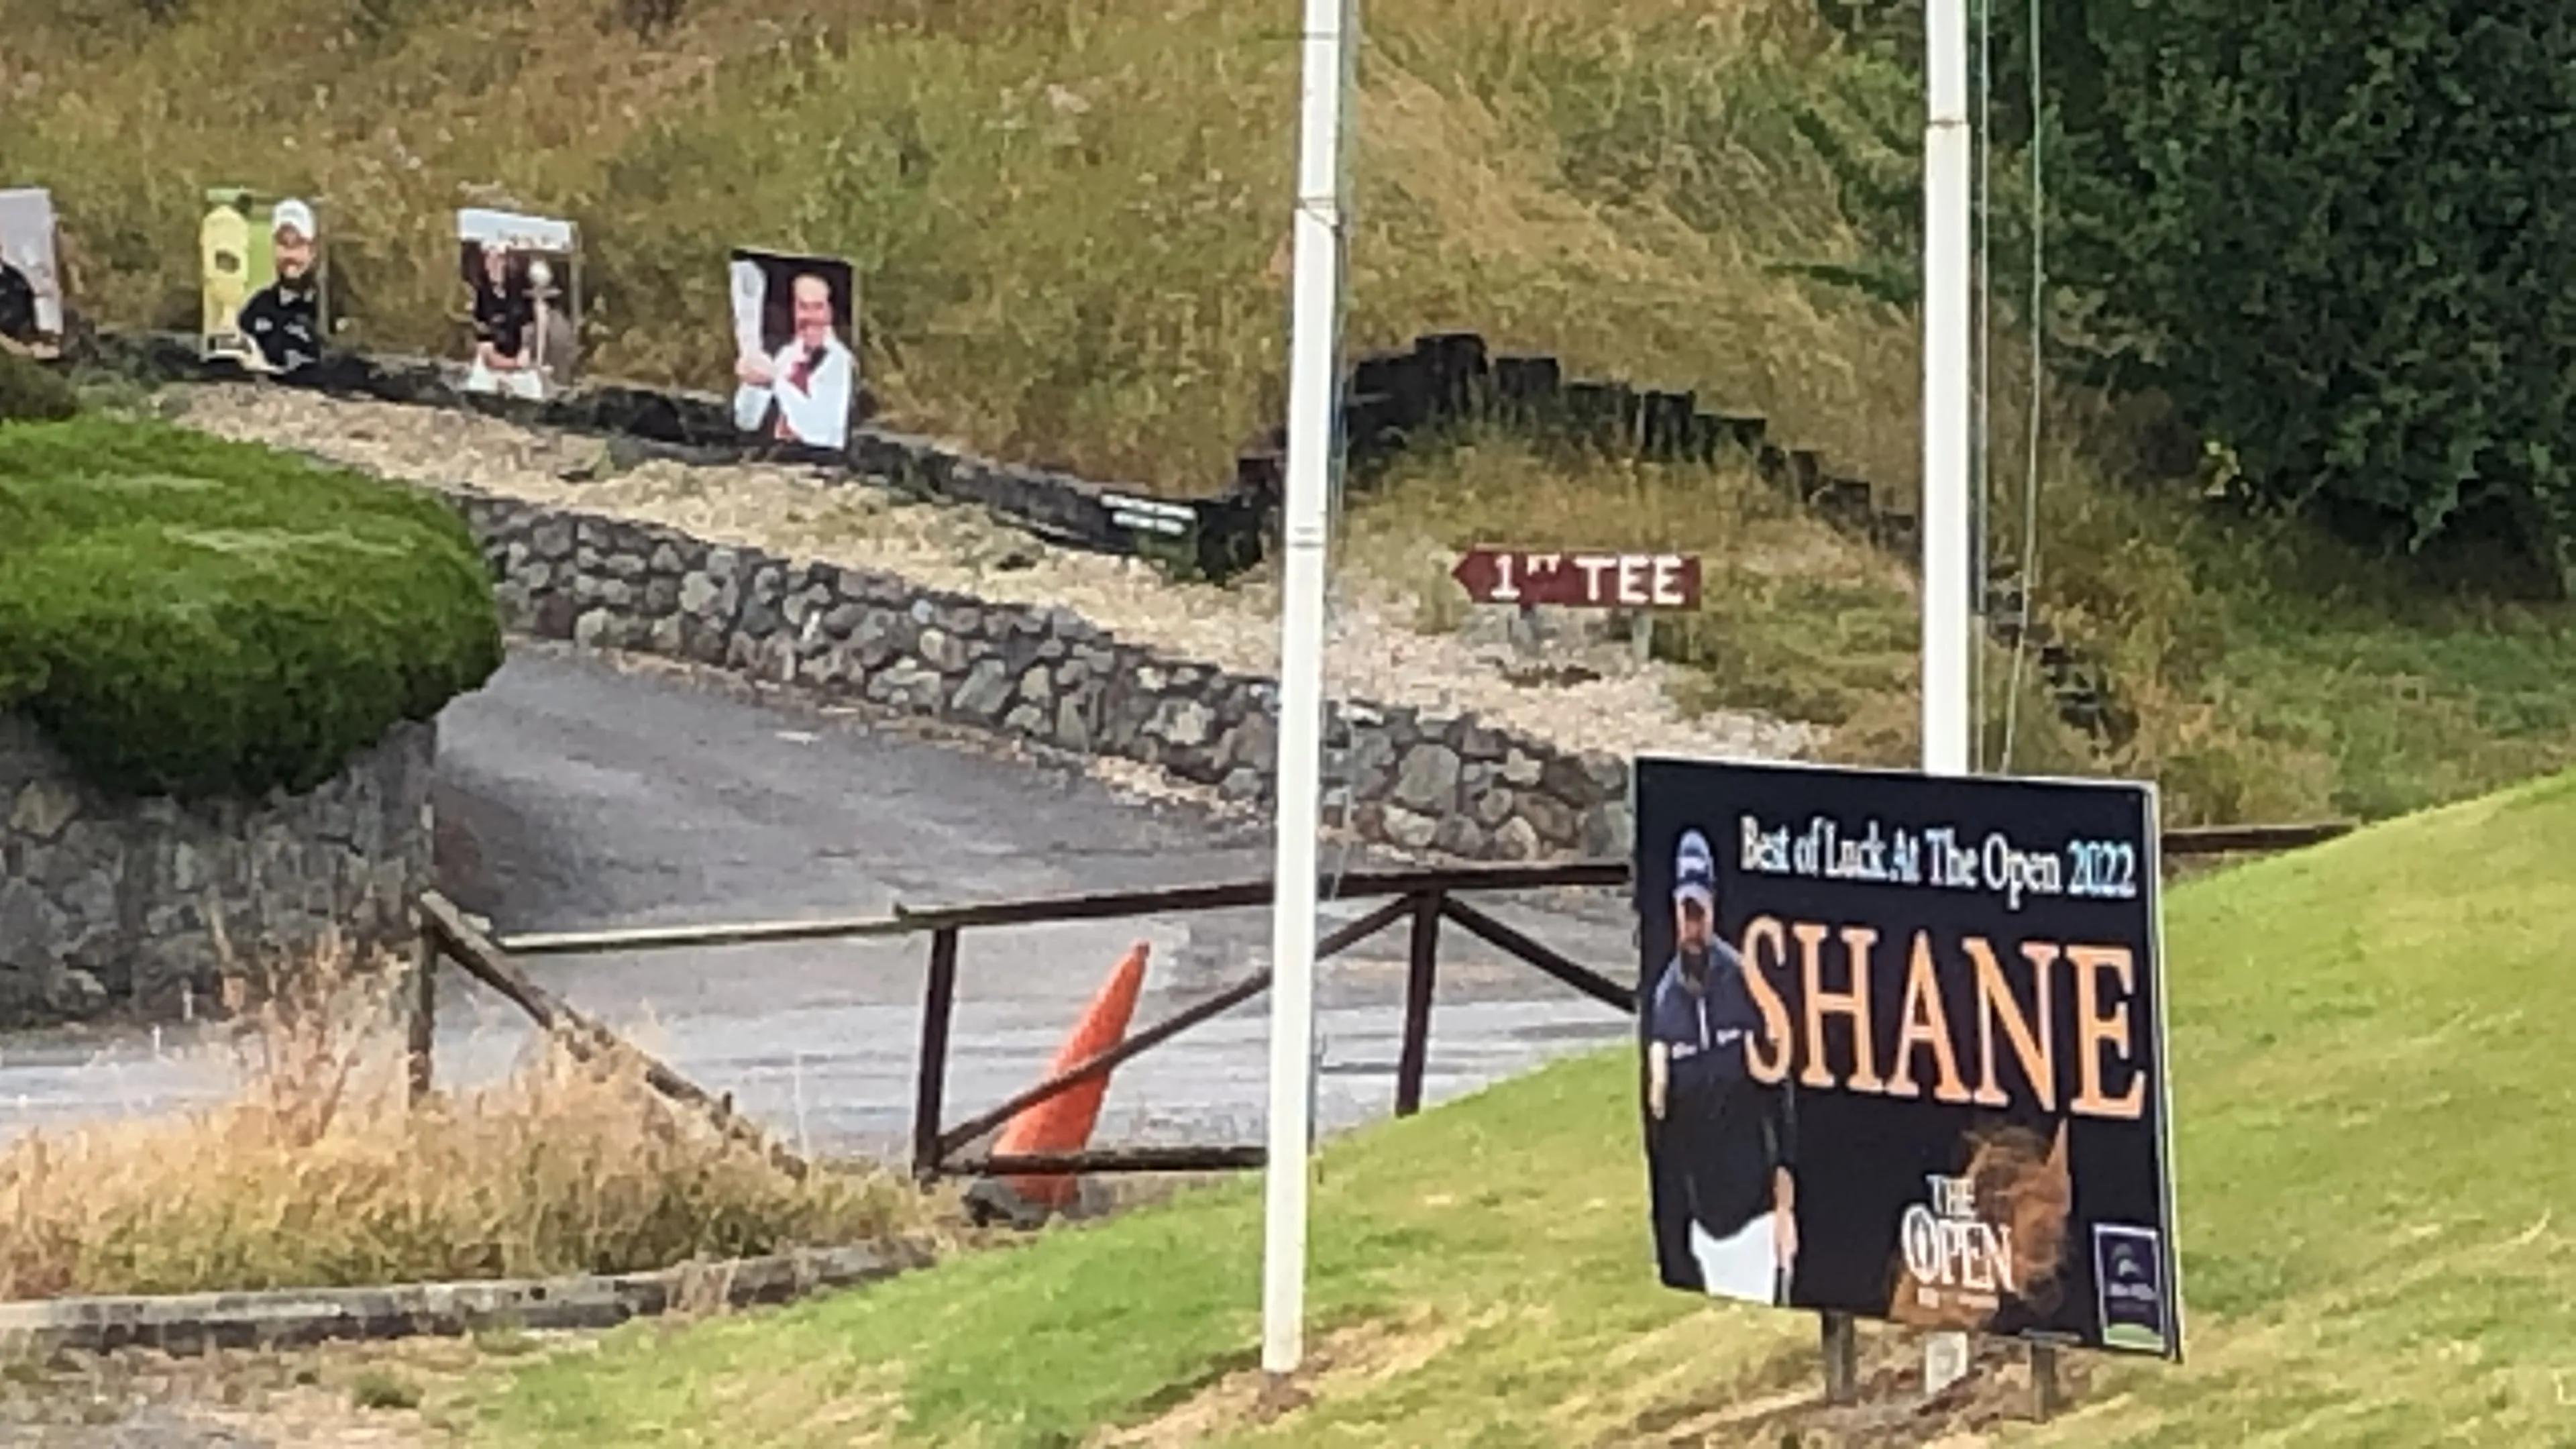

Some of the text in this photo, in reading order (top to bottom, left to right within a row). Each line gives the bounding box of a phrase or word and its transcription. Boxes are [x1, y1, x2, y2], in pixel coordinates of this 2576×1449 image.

[1573, 553, 1683, 604] TEE
[1741, 816, 2137, 910] Best of Luck At The Open 2022
[1743, 916, 2145, 1119] SHANE
[1925, 1175, 1976, 1219] THE
[1901, 1203, 2017, 1293] OPEN
